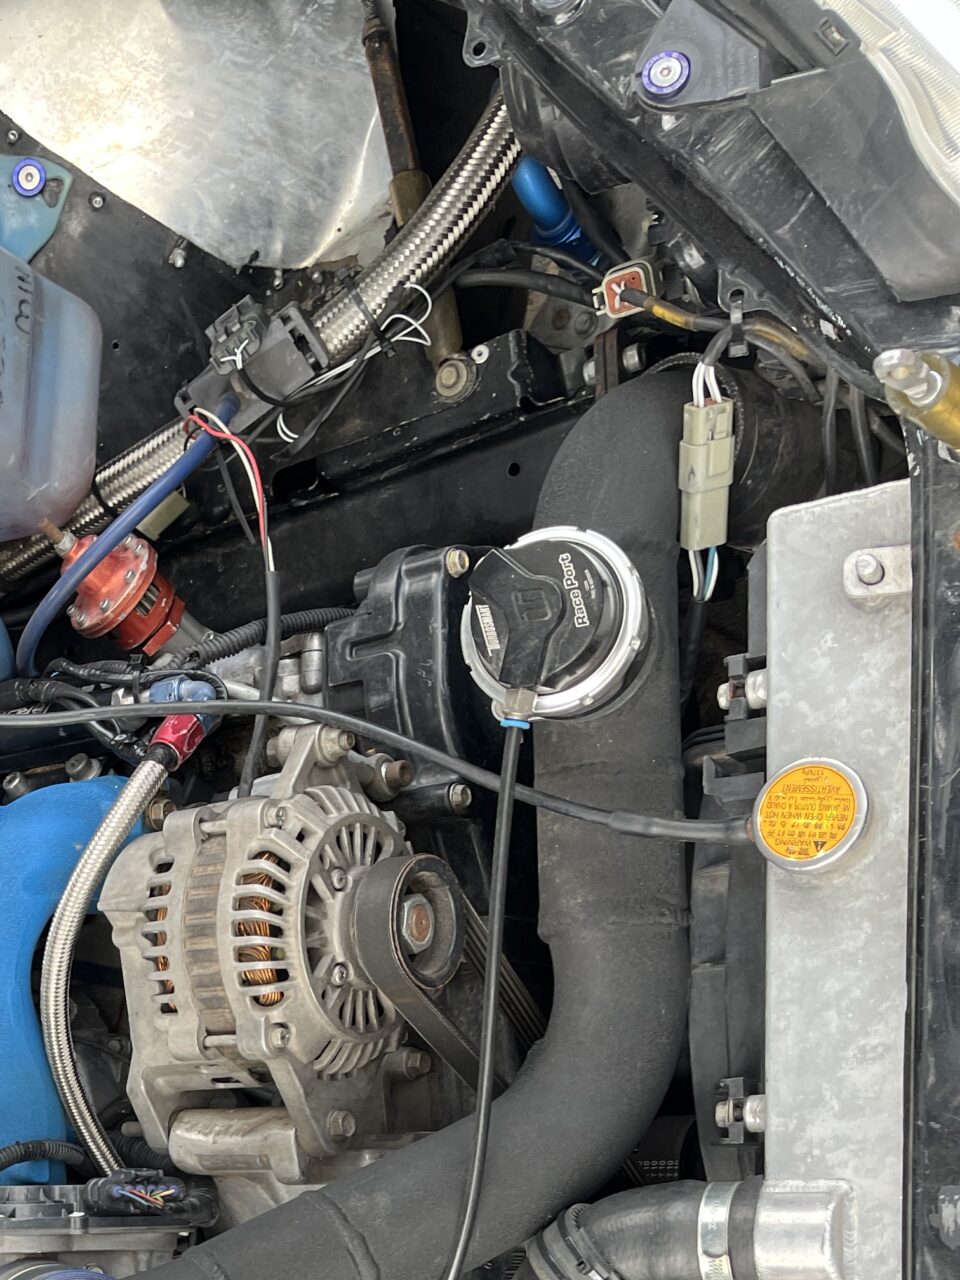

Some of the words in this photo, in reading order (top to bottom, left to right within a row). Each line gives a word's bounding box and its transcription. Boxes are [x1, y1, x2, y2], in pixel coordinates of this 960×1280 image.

[14, 265, 33, 335] MIN
[559, 552, 578, 589] Port
[570, 589, 589, 628] Race
[783, 784, 841, 794] AVERTISSEMENT
[765, 810, 779, 819] HOT
[781, 811, 802, 820] WHEN
[804, 813, 823, 821] OPEN
[826, 813, 848, 822] NEVER
[775, 838, 812, 847] WARNING
